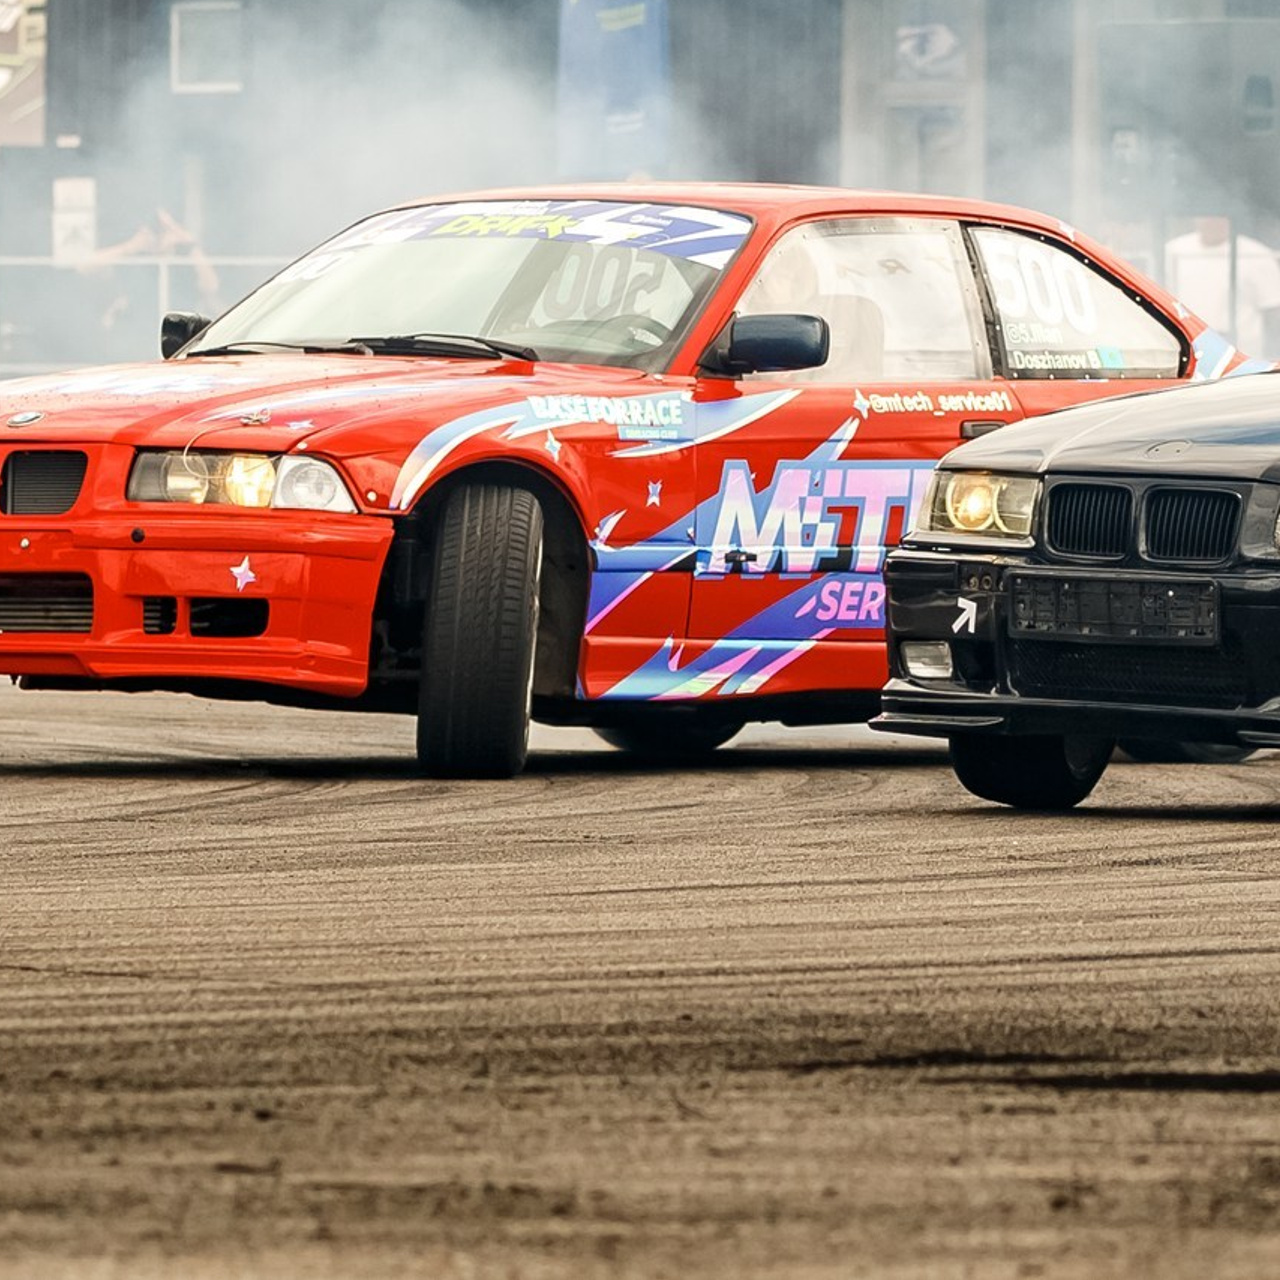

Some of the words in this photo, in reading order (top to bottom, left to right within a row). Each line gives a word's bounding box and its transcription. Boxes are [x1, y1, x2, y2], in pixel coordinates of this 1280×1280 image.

[980, 237, 1098, 333] 500
[1013, 350, 1087, 369] Doszhanov
[869, 390, 1013, 417] @mtech_service01
[816, 581, 887, 620] SER
